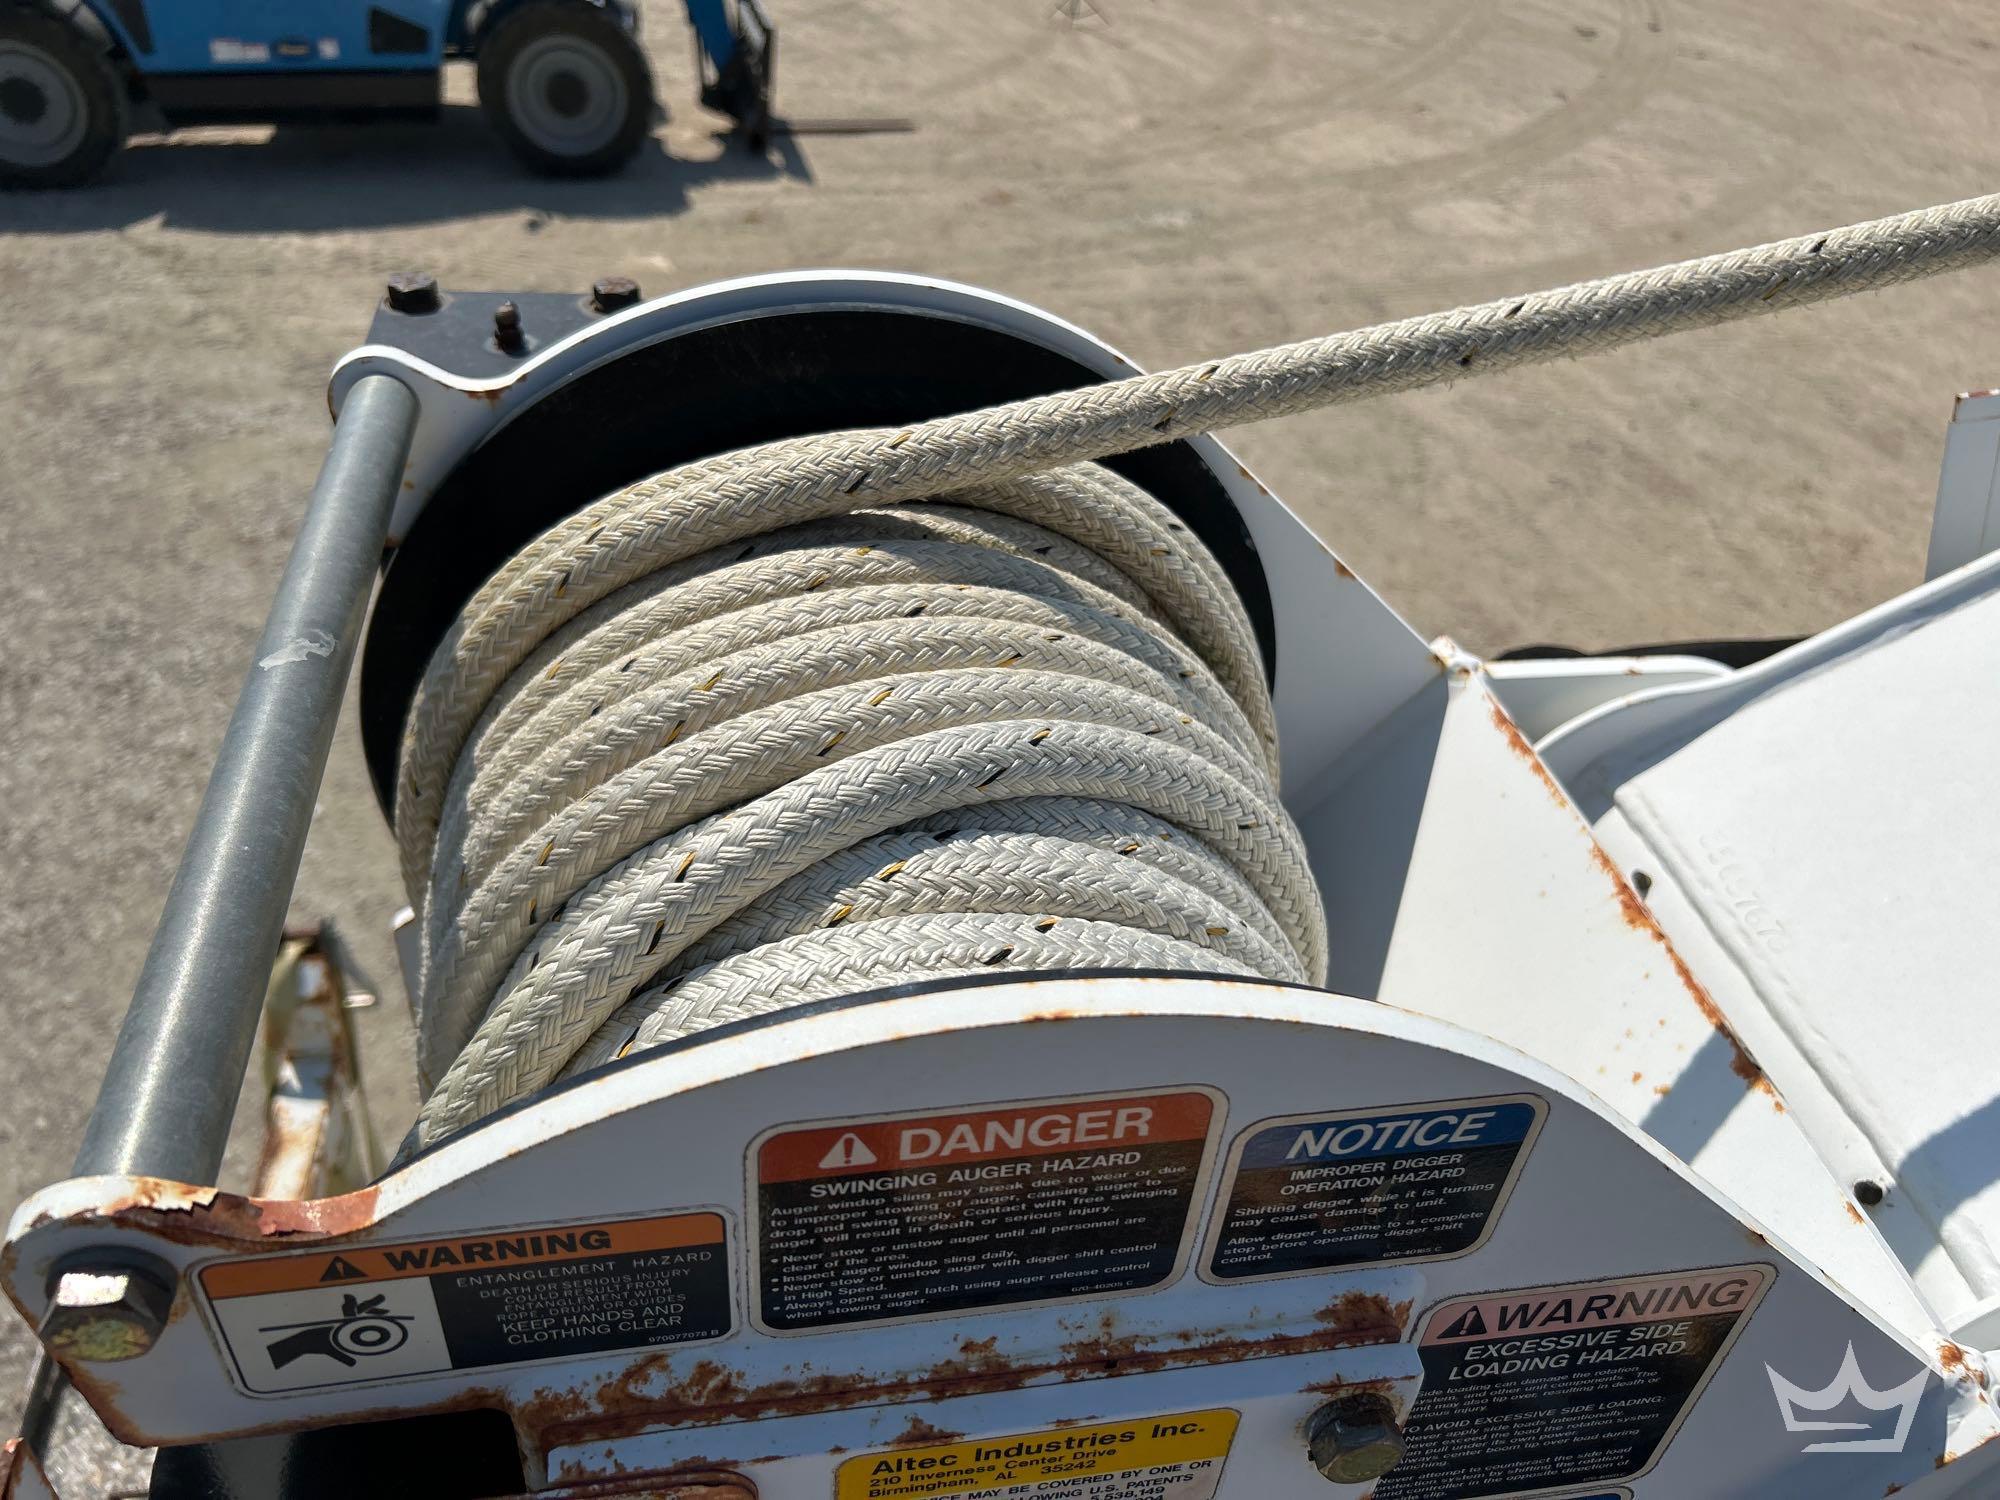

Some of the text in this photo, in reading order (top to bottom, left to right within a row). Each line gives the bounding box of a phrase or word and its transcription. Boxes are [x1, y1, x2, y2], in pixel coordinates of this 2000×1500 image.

[899, 1107, 1153, 1160] DANGER
[1286, 1112, 1495, 1160] NOTICE
[811, 1152, 1141, 1197] SWINGING AUGER HAZARD
[1280, 1167, 1465, 1195] OPERATION HAZARD
[1291, 1154, 1463, 1180] IMPROPER DIGGER
[771, 1205, 819, 1216] Auger
[827, 1198, 885, 1210] windup
[893, 1193, 931, 1202] sling
[938, 1189, 971, 1197] may
[979, 1182, 1023, 1193] break
[1032, 1179, 1060, 1187] due
[1068, 1176, 1084, 1184] to
[1092, 1172, 1128, 1181] wear
[794, 1211, 867, 1224] improper
[876, 1203, 939, 1215] stowing
[946, 1199, 962, 1207] of
[1027, 1187, 1088, 1199] causing
[1095, 1182, 1138, 1191] auger
[1235, 1203, 1296, 1216] Shifting
[1303, 1199, 1353, 1209] digger
[1360, 1193, 1399, 1202] while
[1405, 1190, 1416, 1198] it
[1443, 1183, 1494, 1194] turning
[770, 1229, 806, 1238] drop
[814, 1223, 844, 1233] and
[852, 1219, 898, 1229] swing
[963, 1203, 1026, 1216] Contact
[1034, 1199, 1066, 1208] with
[1073, 1196, 1104, 1204] free
[1112, 1188, 1177, 1200] swinging
[770, 1239, 815, 1249] auger
[823, 1233, 849, 1242] will
[856, 1228, 900, 1239] result
[929, 1220, 974, 1231] death
[1005, 1211, 1061, 1222] serious
[1069, 1206, 1113, 1215] injury.
[1228, 1237, 1265, 1245] Allow
[1271, 1231, 1317, 1240] digger
[1421, 1212, 1483, 1223] complete
[1230, 1219, 1263, 1227] may
[1270, 1213, 1318, 1223] cause
[1325, 1204, 1387, 1217] damage
[1416, 1198, 1446, 1207] unit.
[384, 1230, 612, 1271] WARNING
[783, 1253, 823, 1262] Never
[831, 1249, 864, 1257] stow
[892, 1240, 943, 1250] unstow
[950, 1234, 988, 1244] auger
[995, 1229, 1024, 1239] until
[1030, 1226, 1046, 1235] all
[1051, 1218, 1119, 1233] personnel
[1224, 1222, 1463, 1255] stop before operating digger shift
[457, 1252, 711, 1287] ENTANGLEMENT HAZARD
[783, 1264, 817, 1272] clear
[824, 1260, 839, 1268] of
[875, 1254, 909, 1262] area.
[783, 1250, 1016, 1282] Inspect auger windup sling daily.
[783, 1283, 823, 1292] Never
[830, 1278, 864, 1286] stow
[891, 1269, 940, 1279] unstow
[947, 1264, 985, 1273] auger
[992, 1259, 1020, 1267] with
[1026, 1254, 1069, 1264] digger
[1075, 1249, 1104, 1258] shift
[1110, 1243, 1157, 1254] control
[1221, 1253, 1272, 1264] control.
[480, 1269, 690, 1298] DEATH OR SERIOUS INJURY
[505, 1279, 669, 1304] COULD RESULT FROM
[505, 1287, 672, 1312] ENTANGLEMENT WITH
[785, 1262, 1150, 1310] Always open auger latch using auger release control
[802, 1290, 832, 1299] High
[838, 1284, 886, 1295] Speed.
[503, 1303, 684, 1333] KEEP HANDS AND
[786, 1299, 928, 1319] when stowing auger.
[1497, 1279, 1748, 1332] WARNING
[508, 1316, 681, 1344] CLOTHING CLEAR
[1464, 1322, 1692, 1361] EXCESSIVE SIDE
[1448, 1337, 1688, 1381] LOADING HAZARD
[1424, 1404, 1595, 1431] AVOID EXCESSIVE SIDE
[873, 1423, 1204, 1475] Altec Industries Inc.
[869, 1478, 978, 1497] Birmingham,
[995, 1471, 1016, 1480] AL
[1041, 1460, 1096, 1474] 35242
[870, 1449, 1116, 1487] 210 Inverness Center Drive
[968, 1489, 1001, 1500] MAY
[1009, 1485, 1030, 1494] BE
[1037, 1474, 1114, 1490] COVERED
[1121, 1469, 1142, 1479] BY
[1149, 1464, 1182, 1475] ONE
[1189, 1460, 1212, 1470] OR
[1089, 1474, 1193, 1494] U.S. PATENTS
